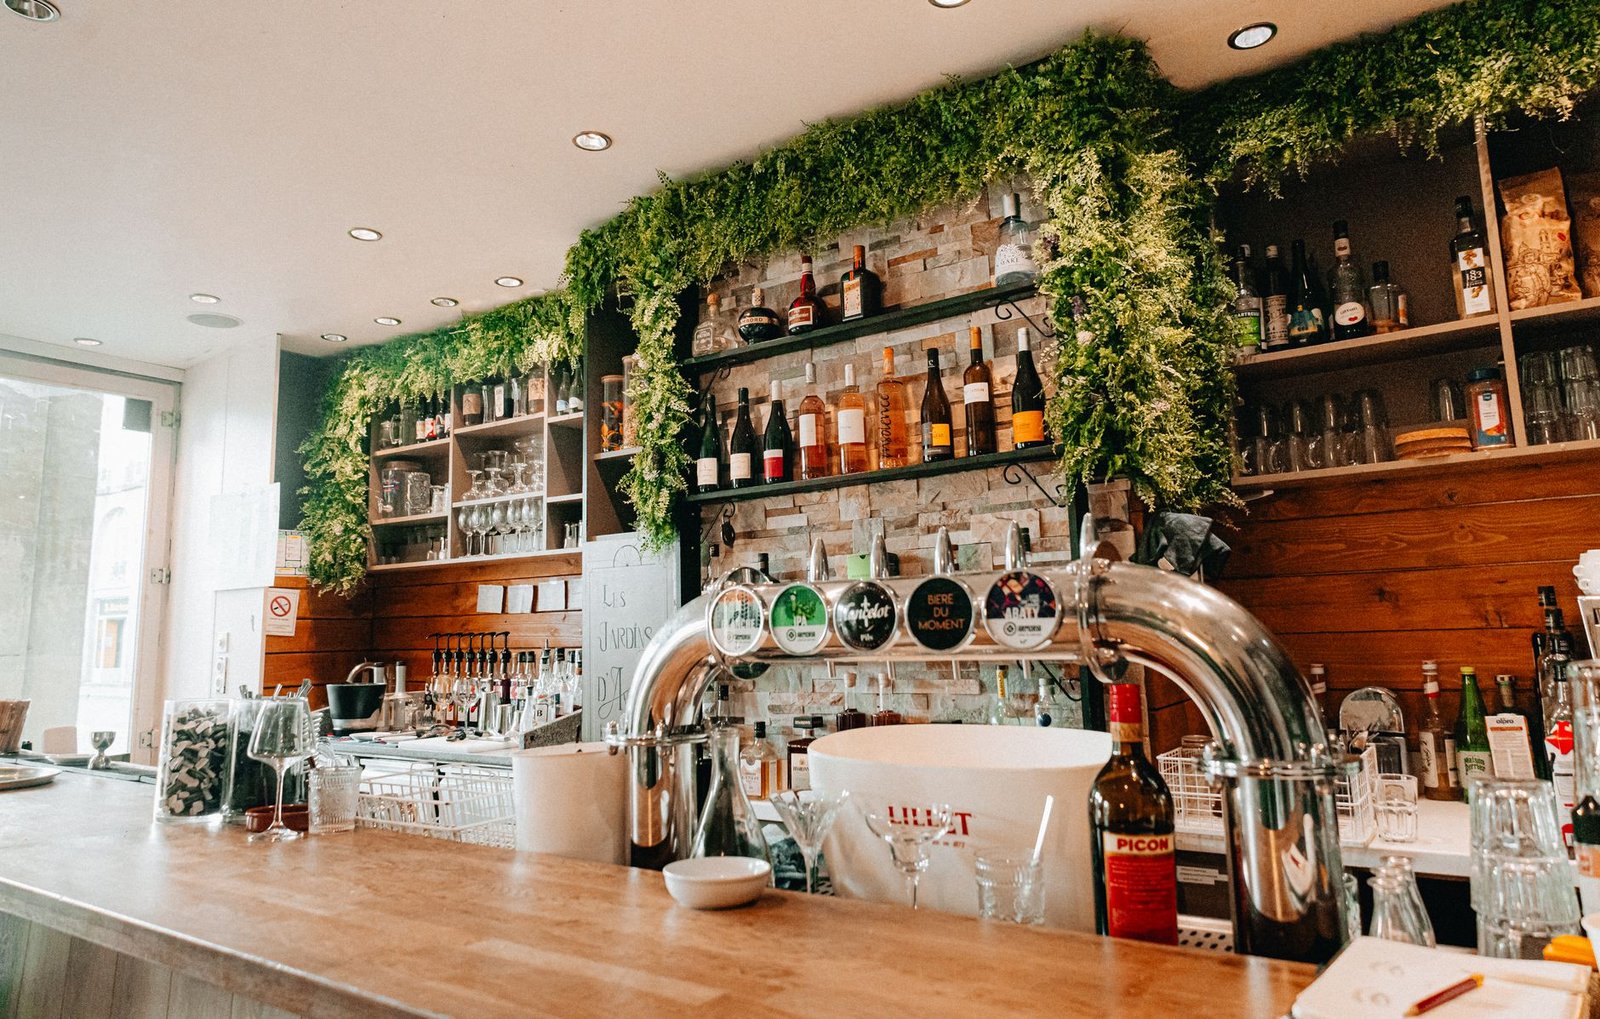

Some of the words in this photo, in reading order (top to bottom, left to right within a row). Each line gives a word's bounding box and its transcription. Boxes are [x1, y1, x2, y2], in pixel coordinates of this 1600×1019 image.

[933, 607, 949, 617] DU
[918, 619, 964, 630] MOMENT
[1117, 838, 1169, 851] PICON
